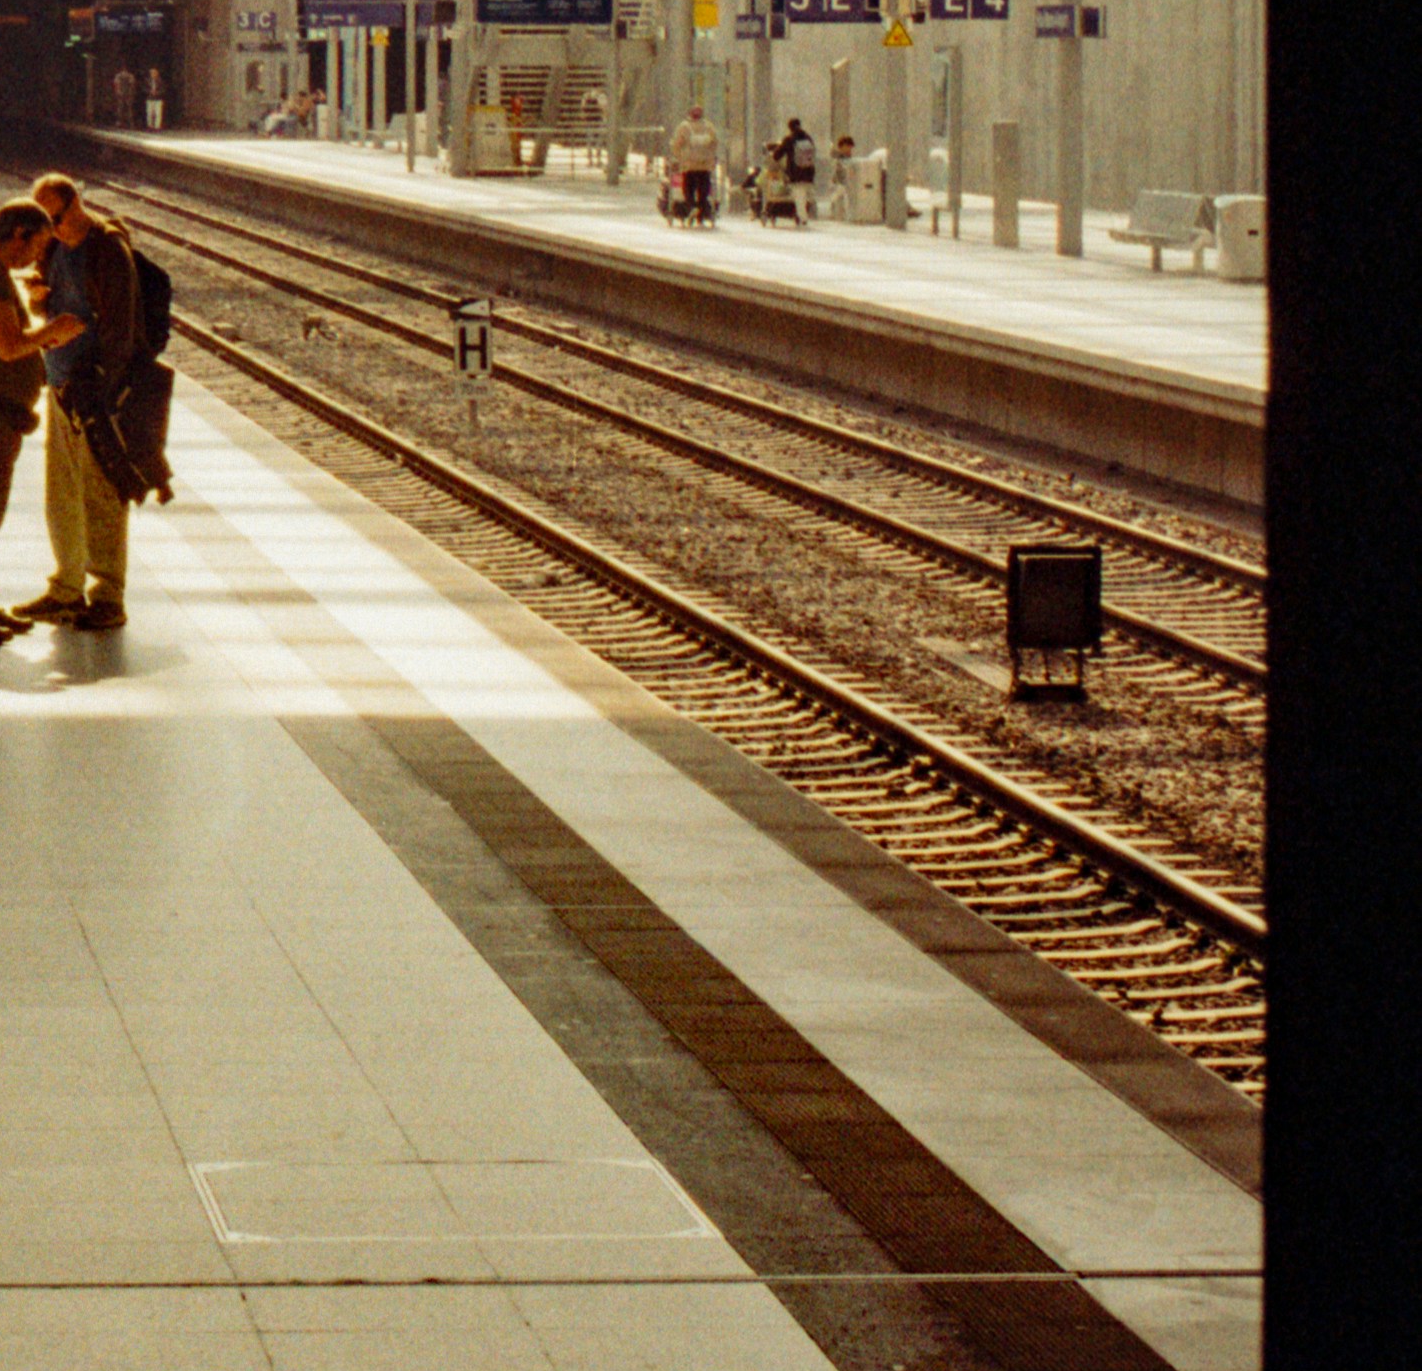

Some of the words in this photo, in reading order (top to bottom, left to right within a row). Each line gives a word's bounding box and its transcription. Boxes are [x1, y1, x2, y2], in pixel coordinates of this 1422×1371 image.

[237, 12, 249, 28] 3
[259, 12, 272, 28] C
[459, 325, 488, 371] H
